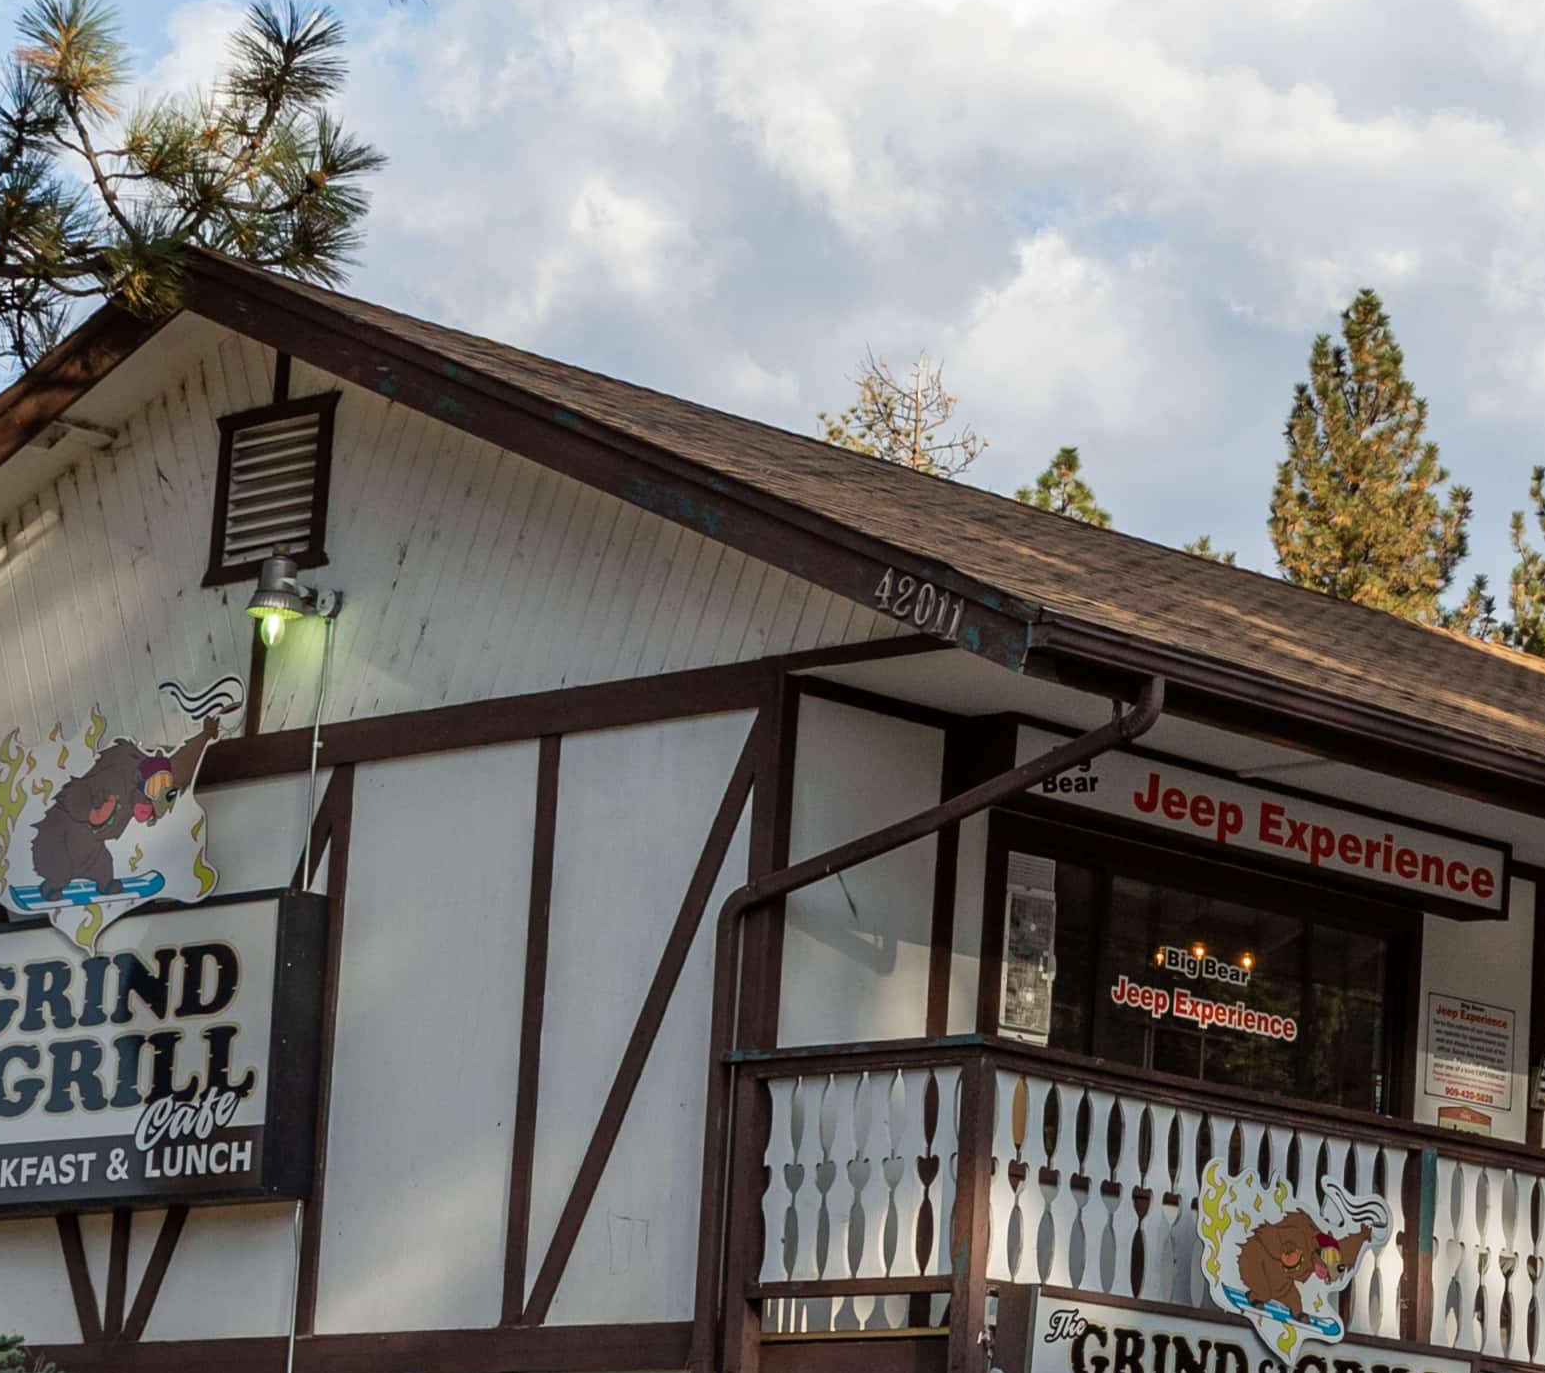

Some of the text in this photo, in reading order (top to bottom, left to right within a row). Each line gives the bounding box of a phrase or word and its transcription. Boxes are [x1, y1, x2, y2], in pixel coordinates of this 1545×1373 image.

[874, 566, 966, 641] 42011
[1042, 776, 1099, 794] Bear
[1133, 773, 1496, 898] Jeep Experience
[1166, 948, 1251, 986] Big Bear
[1112, 975, 1297, 1042] Jeep Experience
[135, 1087, 237, 1152] Cafe
[106, 1148, 128, 1181] &
[145, 1141, 253, 1178] LUNCH
[1046, 1309, 1086, 1343] The
